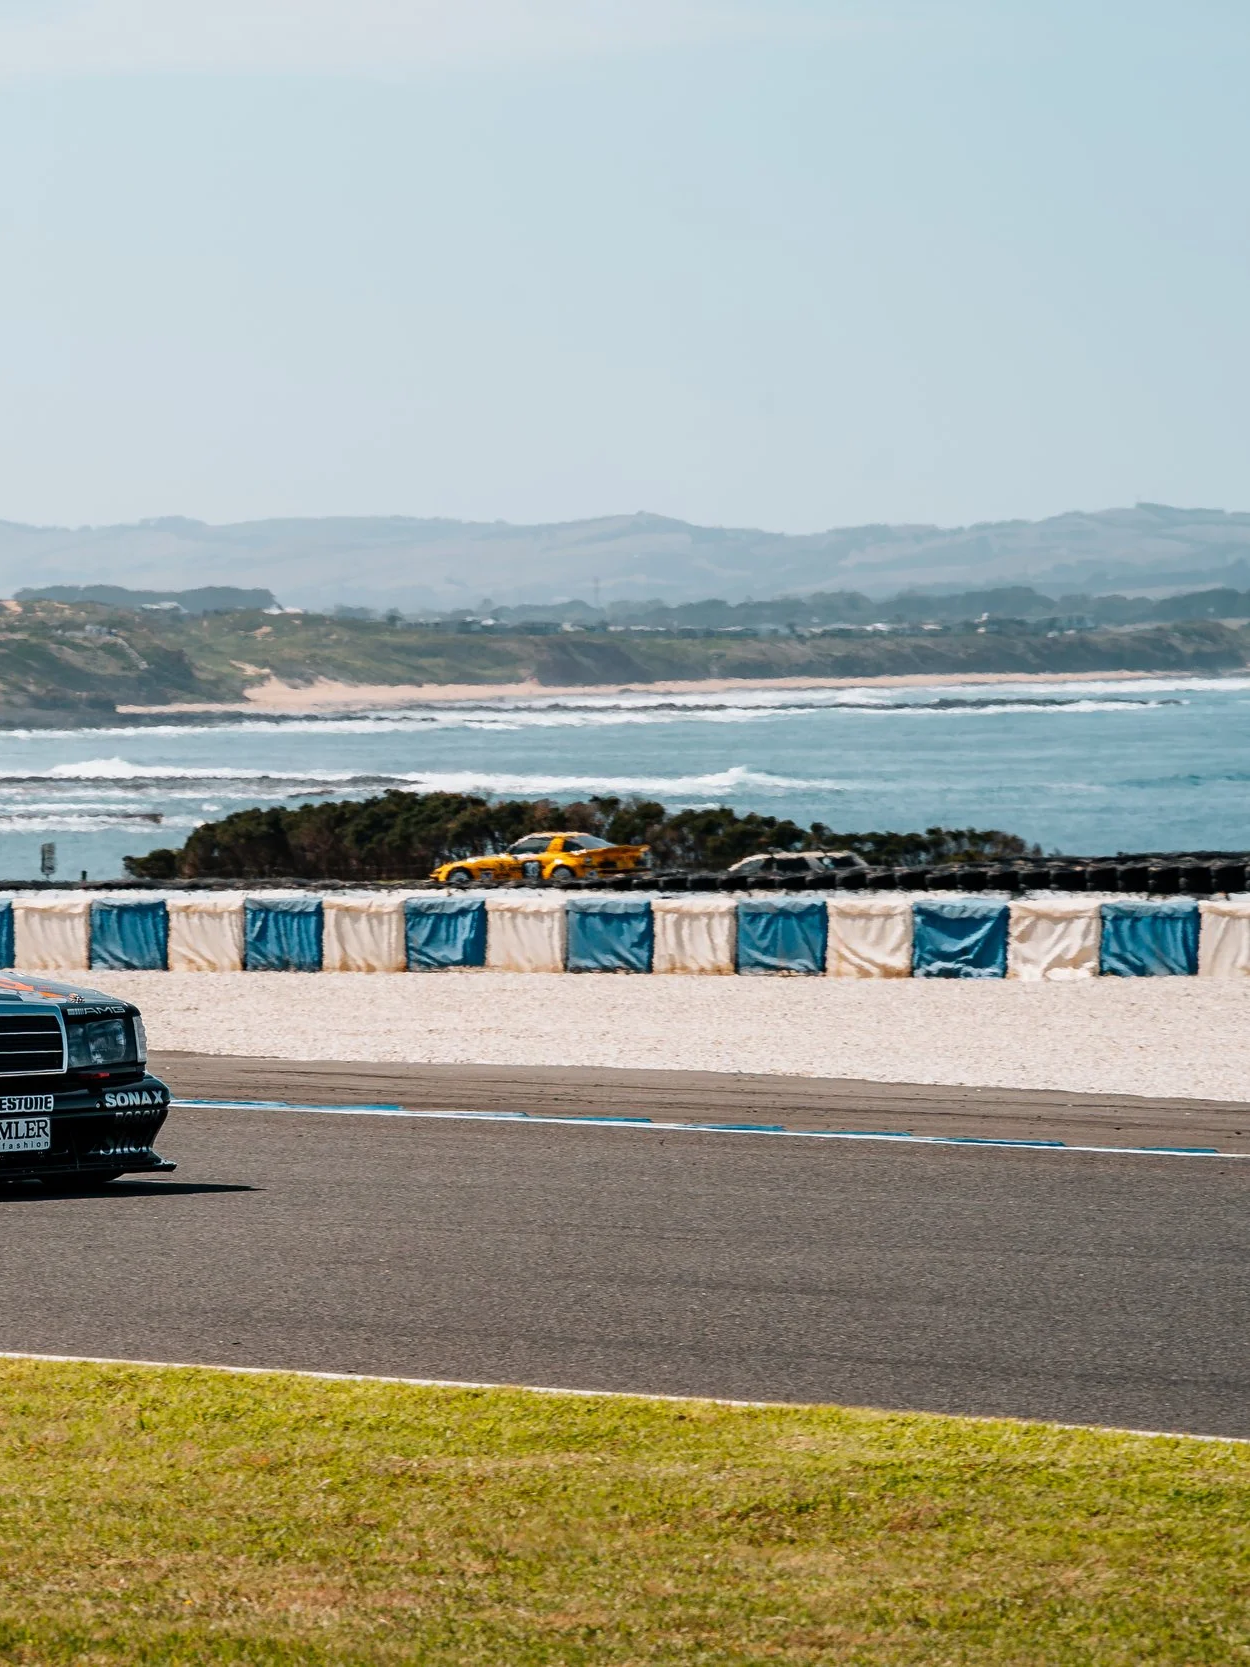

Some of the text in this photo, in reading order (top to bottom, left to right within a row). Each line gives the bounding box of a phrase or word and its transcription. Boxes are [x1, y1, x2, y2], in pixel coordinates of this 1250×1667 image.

[84, 1006, 126, 1015] AMG
[105, 1090, 164, 1108] SONAX
[2, 1140, 49, 1150] fashion
